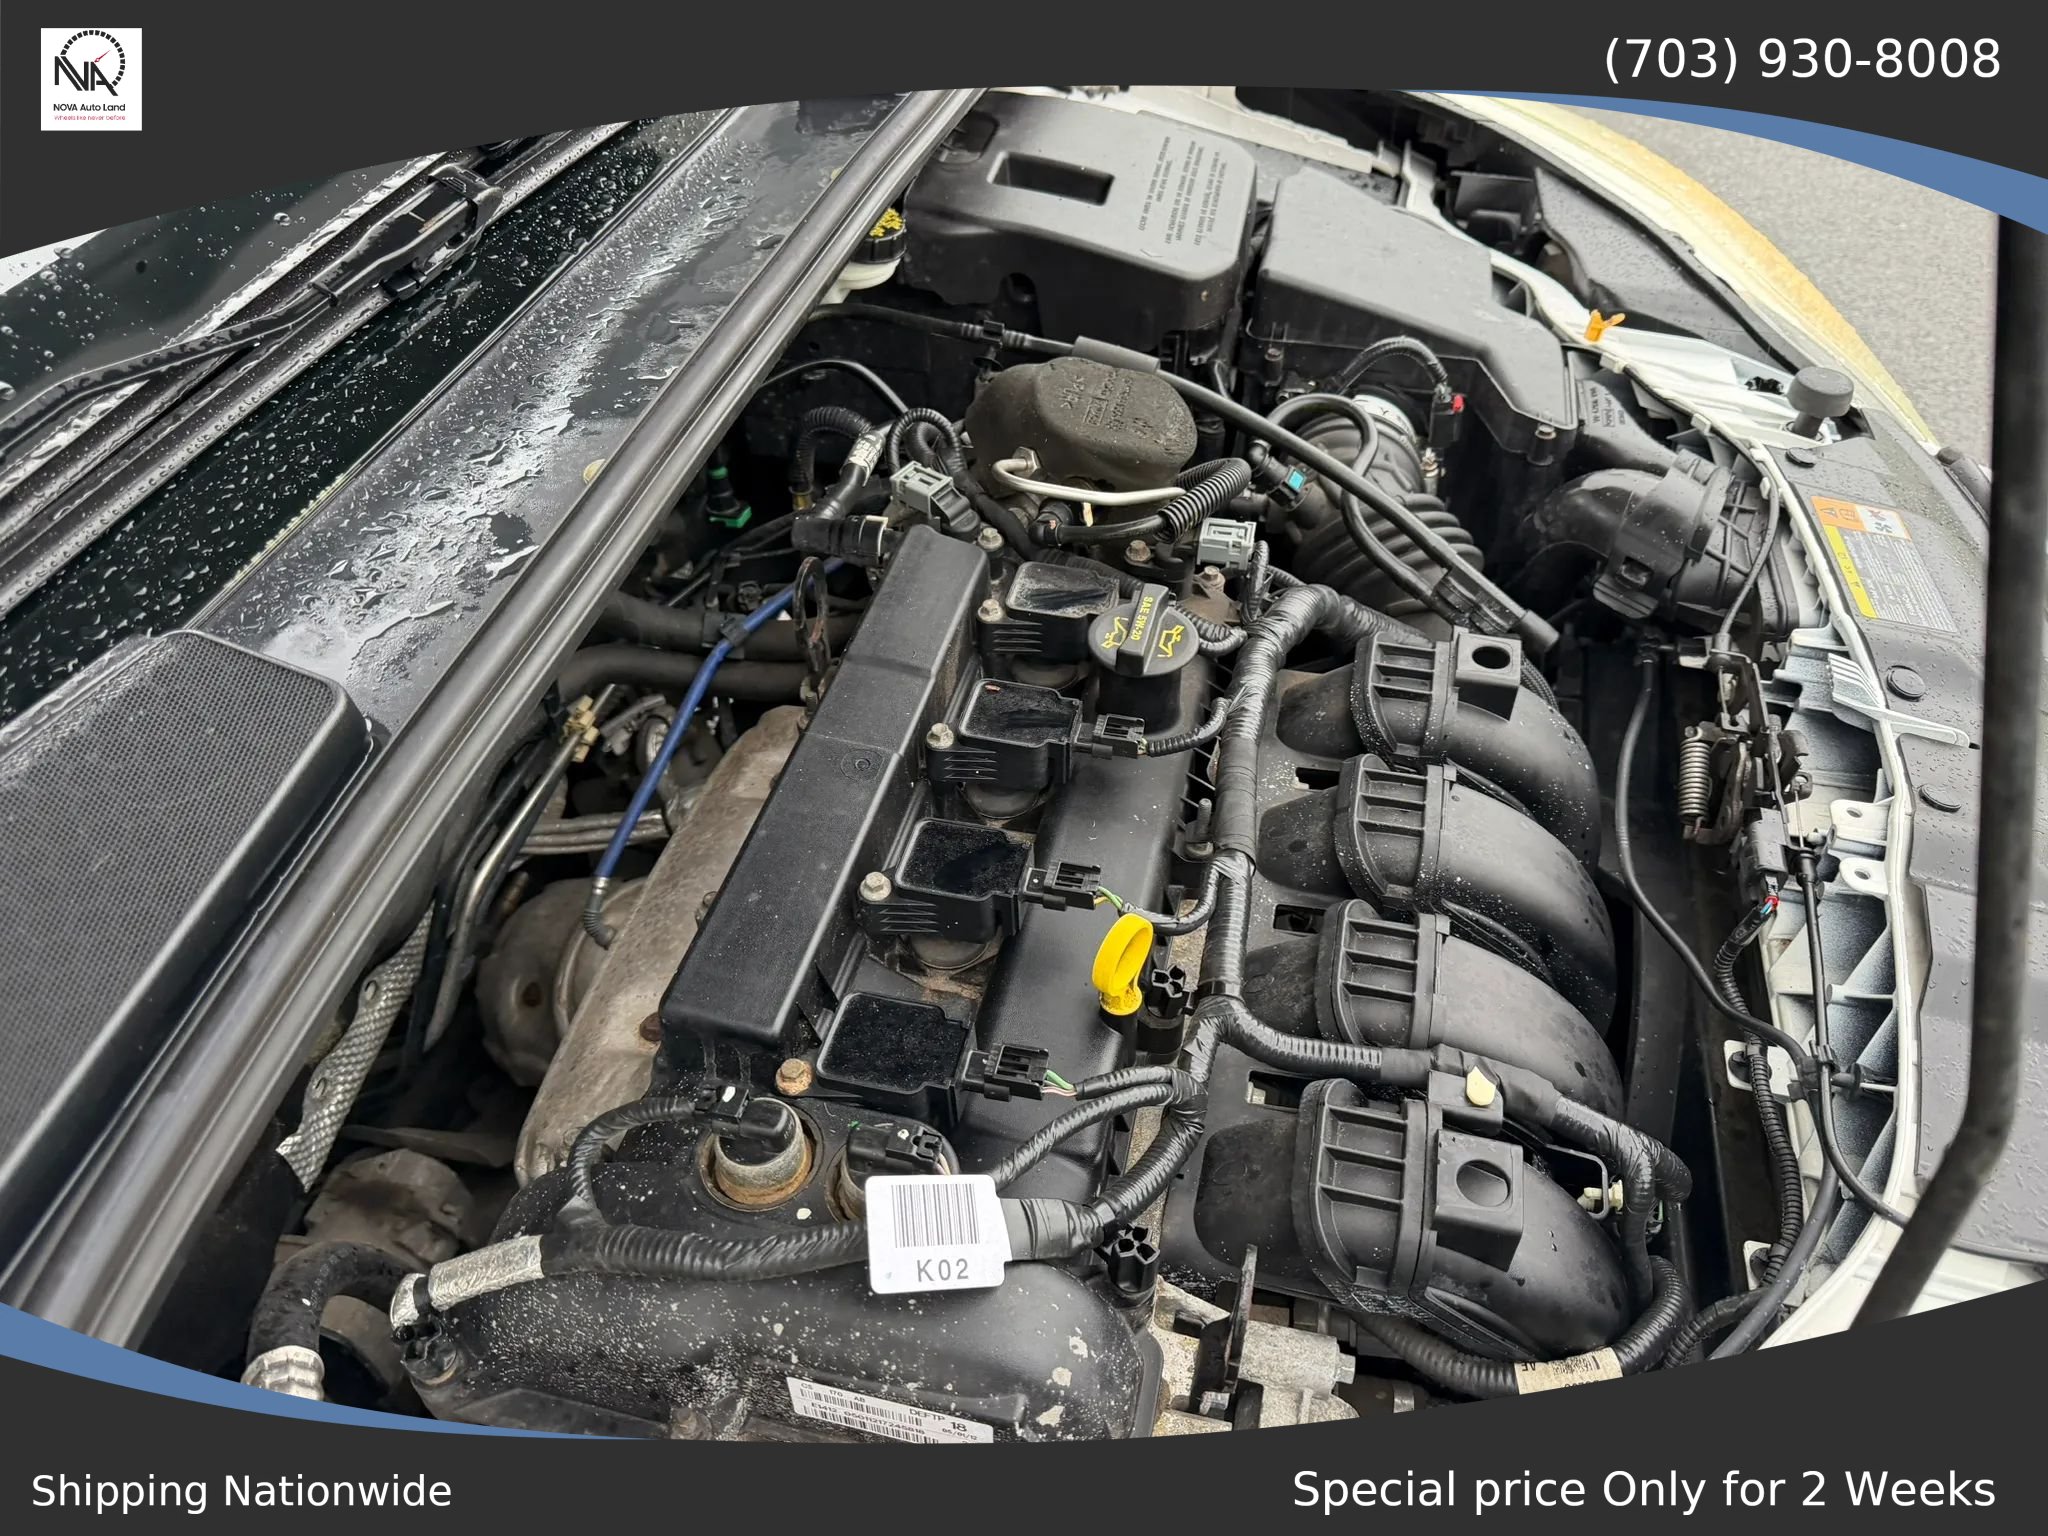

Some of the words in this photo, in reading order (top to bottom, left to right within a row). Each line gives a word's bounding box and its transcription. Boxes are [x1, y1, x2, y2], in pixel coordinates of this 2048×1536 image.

[1140, 596, 1154, 615] SAE
[1130, 614, 1149, 641] 5W-20
[917, 1258, 969, 1283] K02
[950, 1421, 968, 1433] 18
